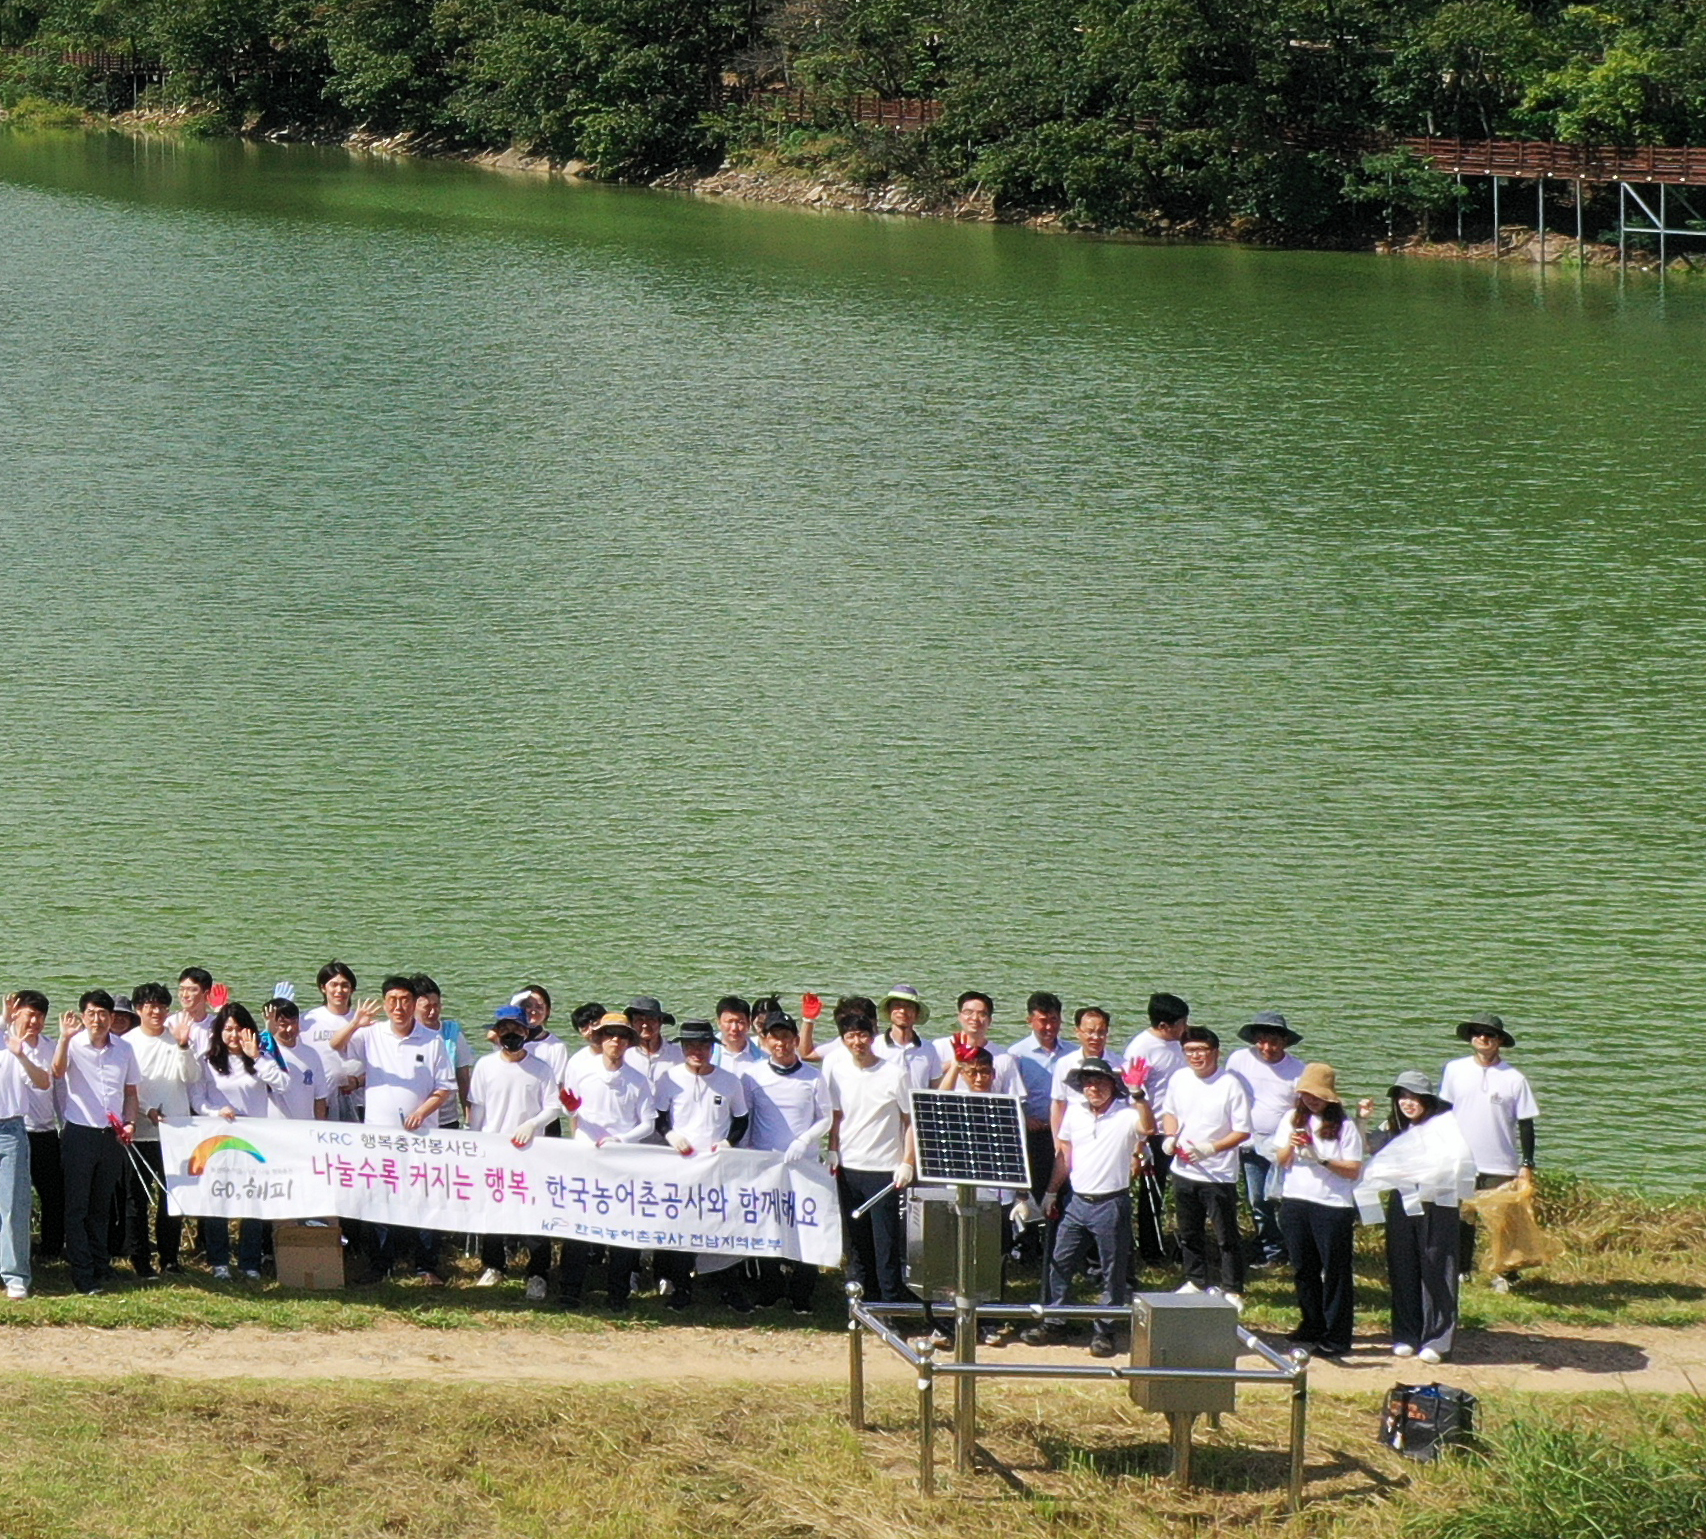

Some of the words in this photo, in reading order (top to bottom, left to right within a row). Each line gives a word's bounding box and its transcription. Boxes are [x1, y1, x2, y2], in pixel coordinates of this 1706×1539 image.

[312, 1152, 400, 1195] 나눌수록
[410, 1162, 474, 1200] 커지는
[484, 1167, 536, 1206] 행복,
[545, 1175, 728, 1223] 한국농어촌공사와
[738, 1186, 819, 1228] 함께해요
[574, 1223, 684, 1245] 한국농어촌공사
[690, 1233, 783, 1250] 전남지역본부
